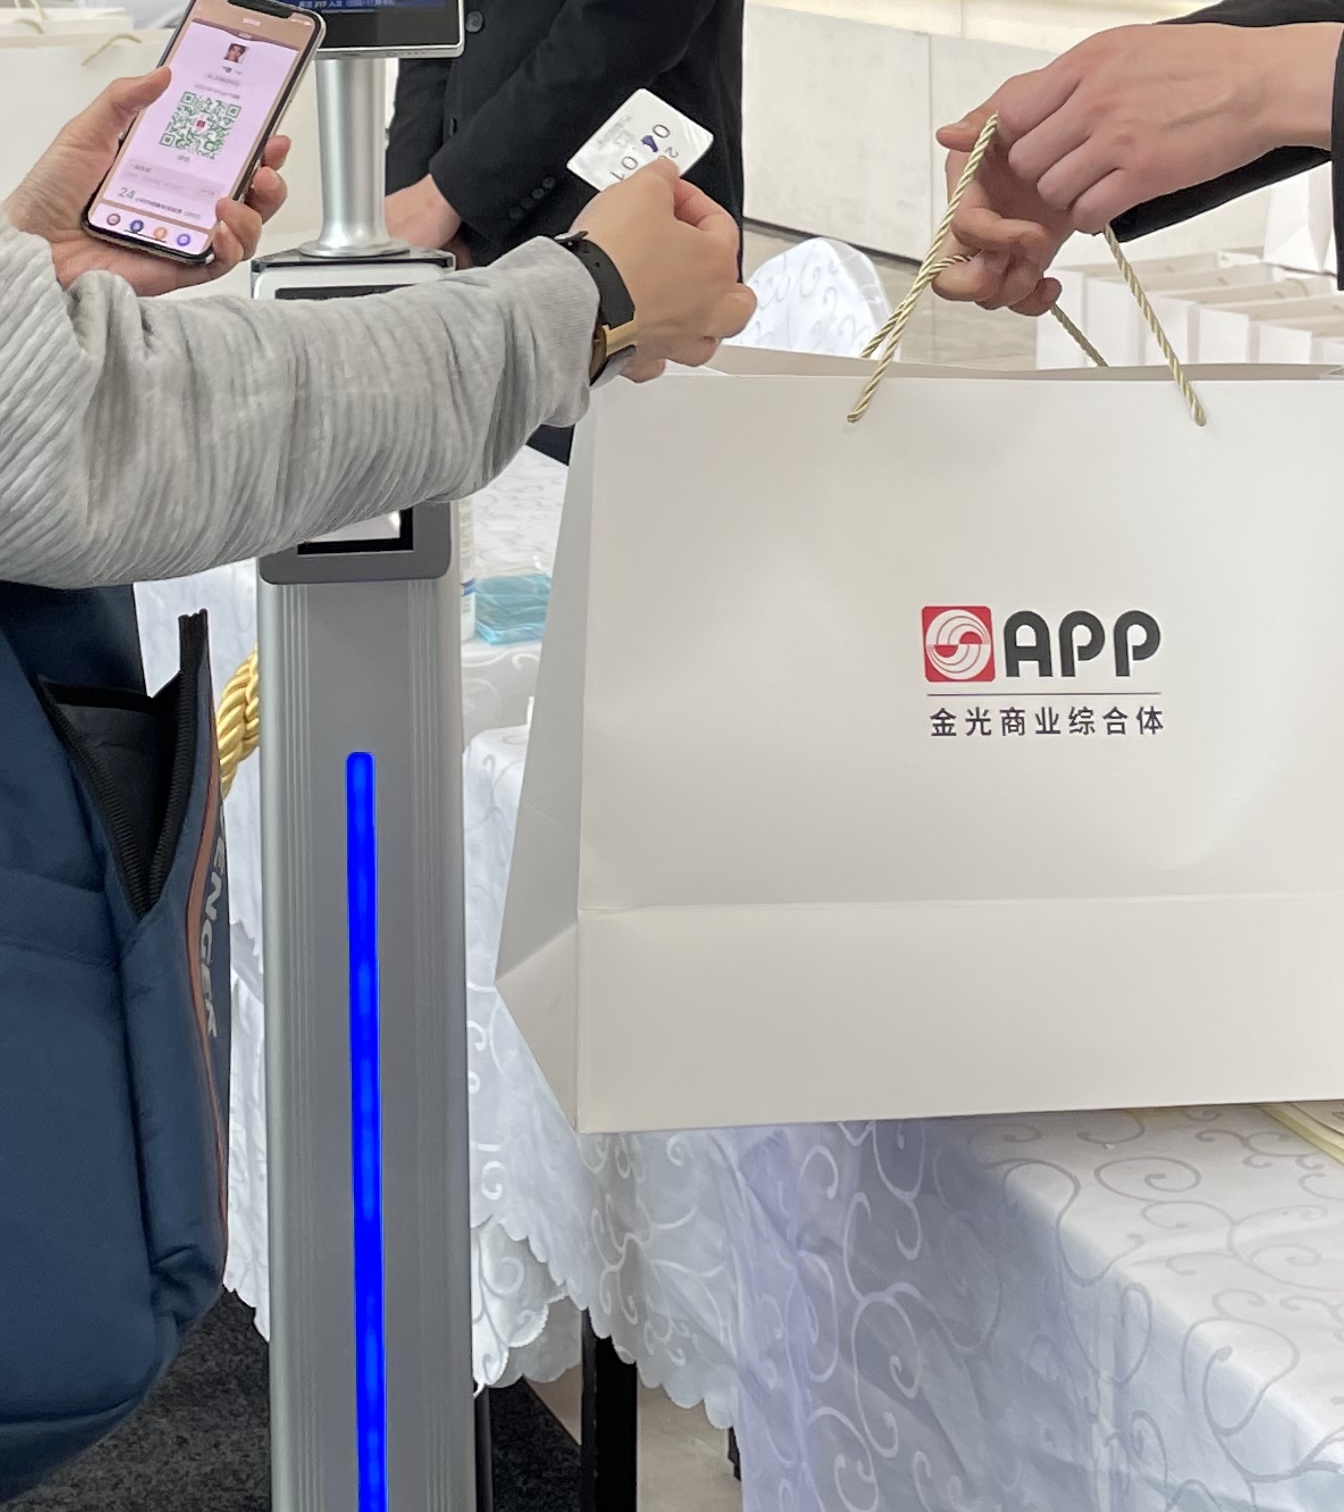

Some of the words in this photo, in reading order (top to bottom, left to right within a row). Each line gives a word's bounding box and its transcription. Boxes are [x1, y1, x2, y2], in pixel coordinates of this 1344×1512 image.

[118, 186, 136, 200] 24
[1003, 609, 1162, 678] APP
[930, 705, 1164, 737] 金光商业综合体
[201, 806, 225, 1038] ENGER
